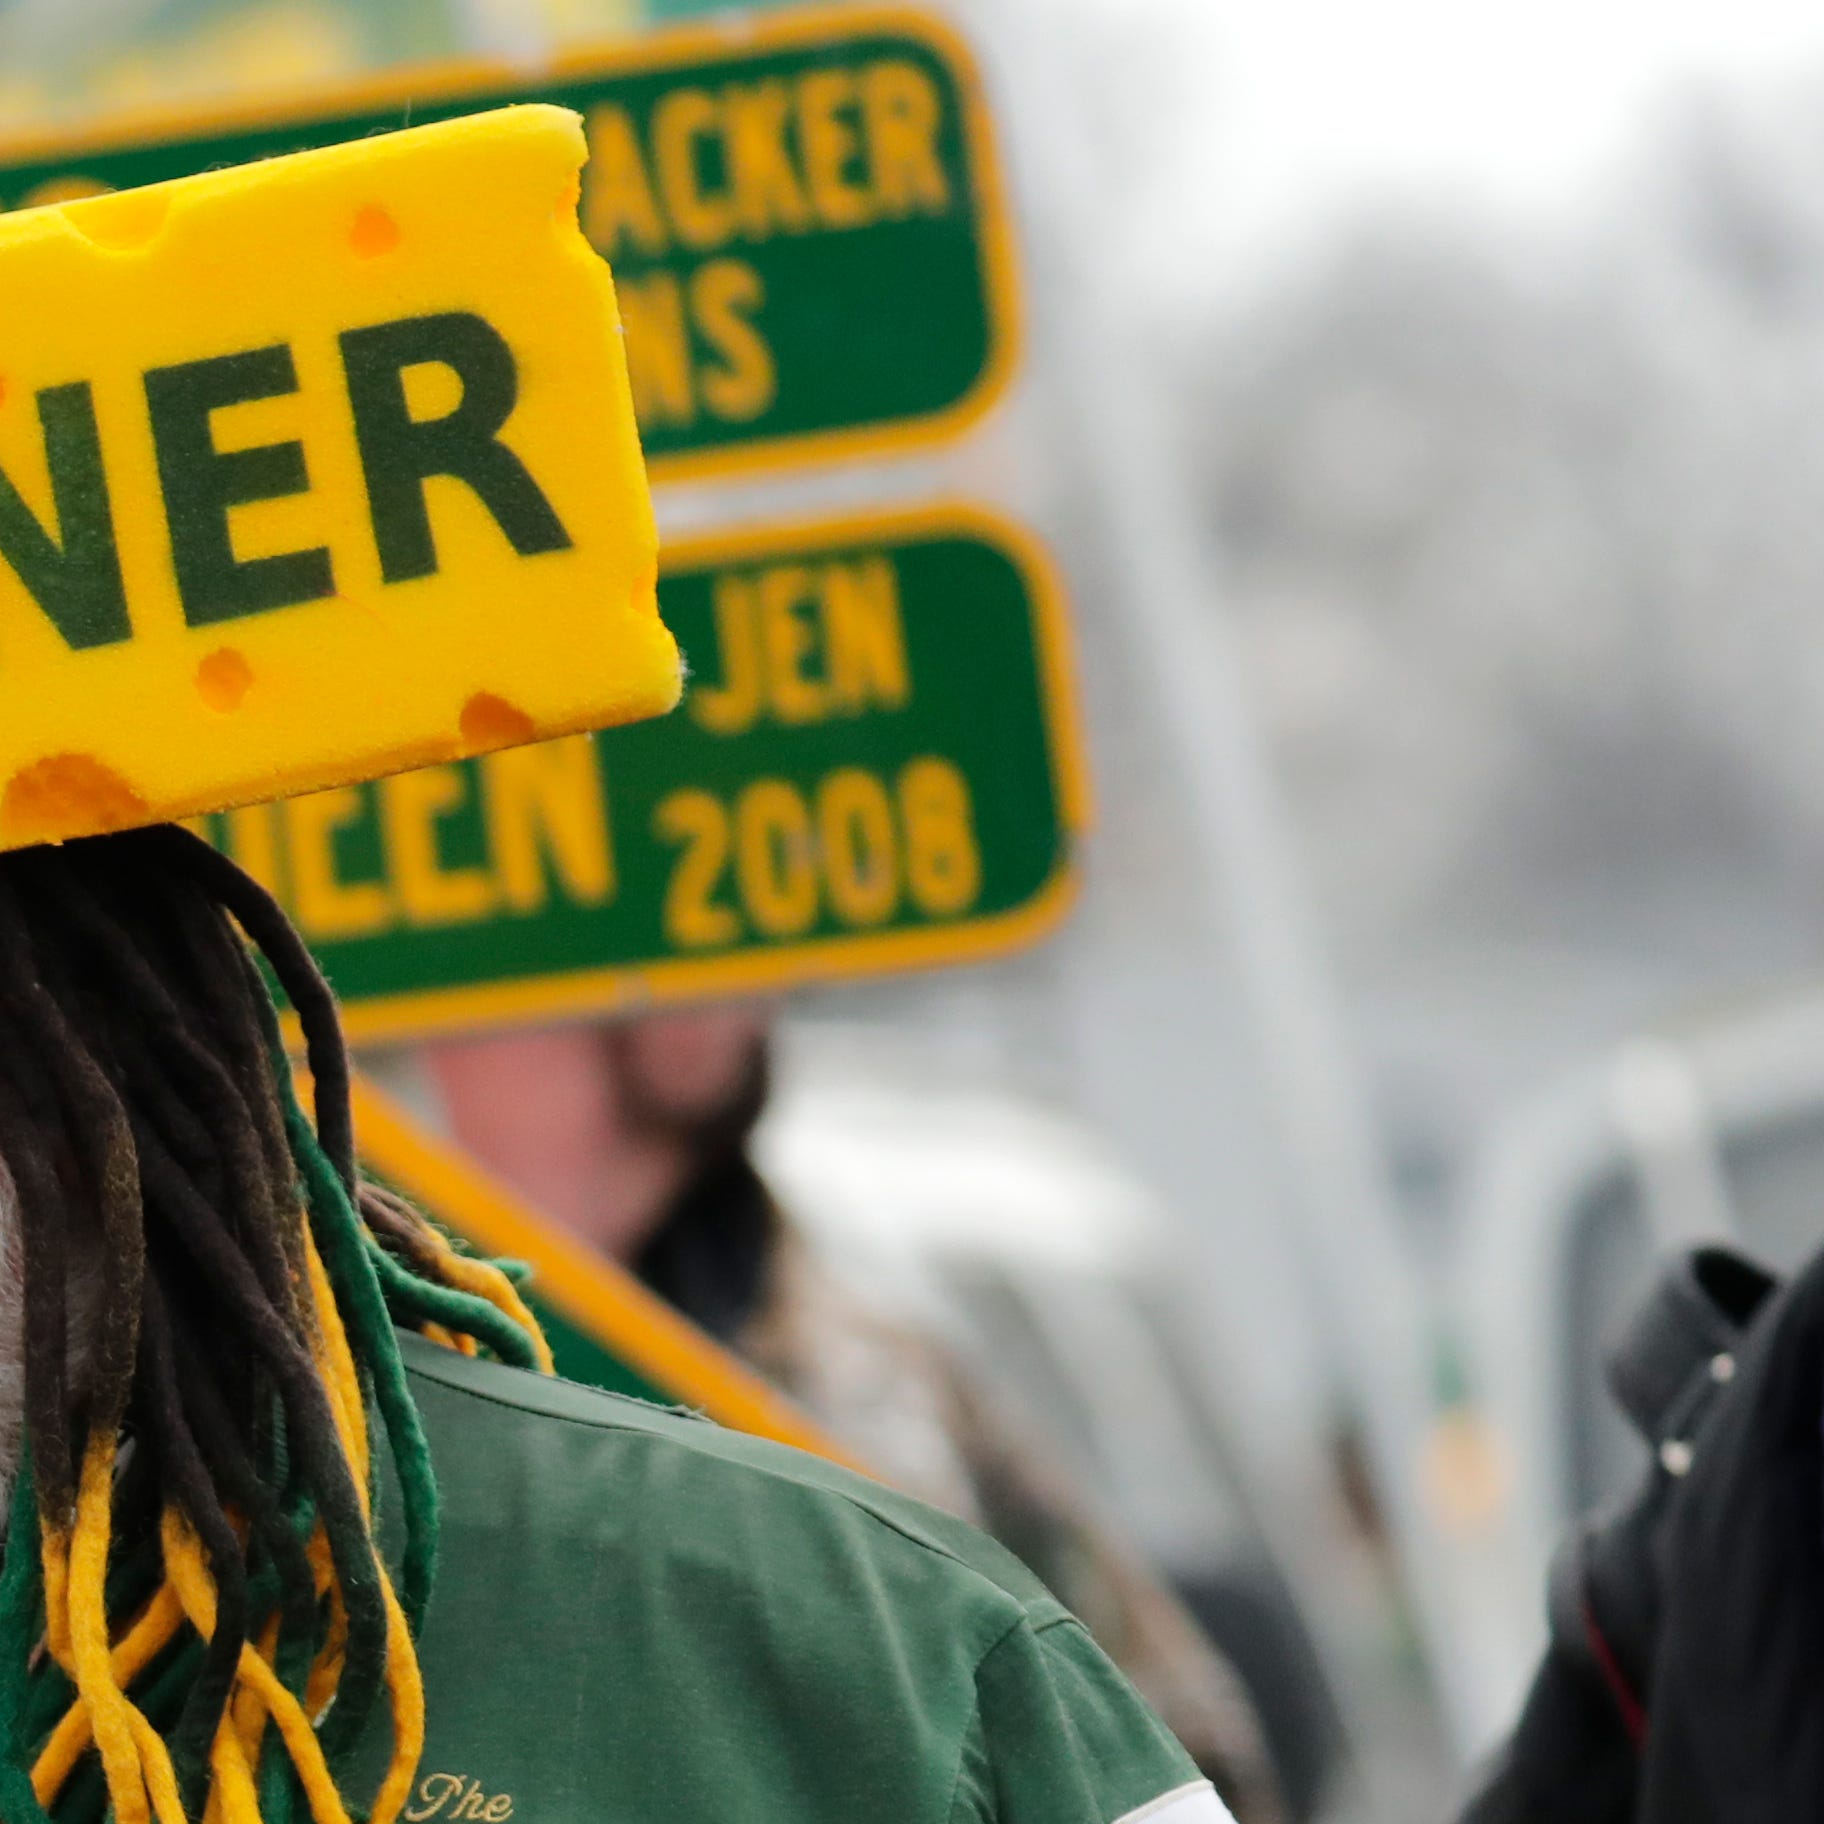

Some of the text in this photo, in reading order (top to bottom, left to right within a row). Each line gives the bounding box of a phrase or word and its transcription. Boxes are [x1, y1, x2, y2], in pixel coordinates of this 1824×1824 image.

[688, 561, 911, 735] JEN
[652, 756, 982, 948] 2008
[404, 1772, 514, 1823] The
